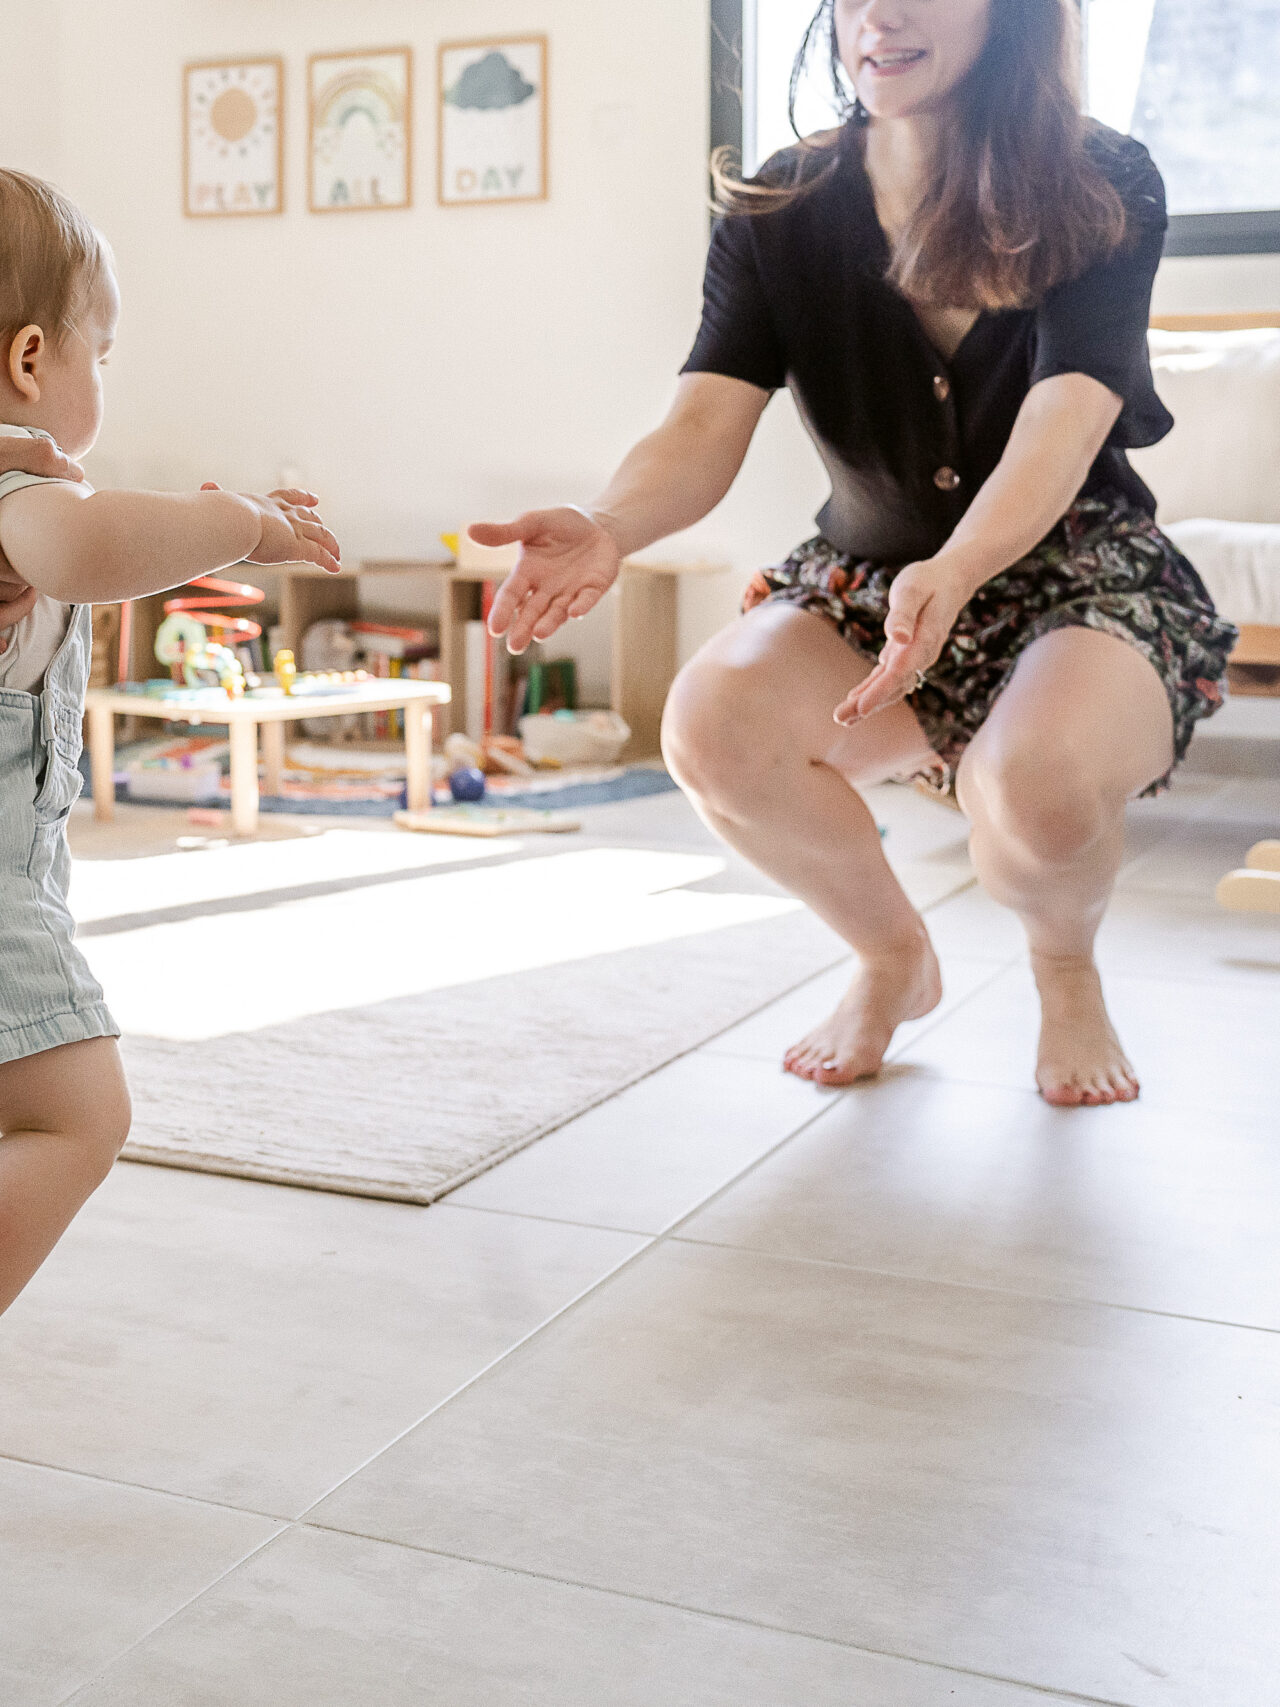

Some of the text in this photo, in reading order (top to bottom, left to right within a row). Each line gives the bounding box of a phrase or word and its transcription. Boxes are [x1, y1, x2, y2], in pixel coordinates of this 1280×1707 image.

[329, 177, 386, 205] ALL
[455, 164, 524, 194] DAY
[196, 182, 274, 209] PLAY
